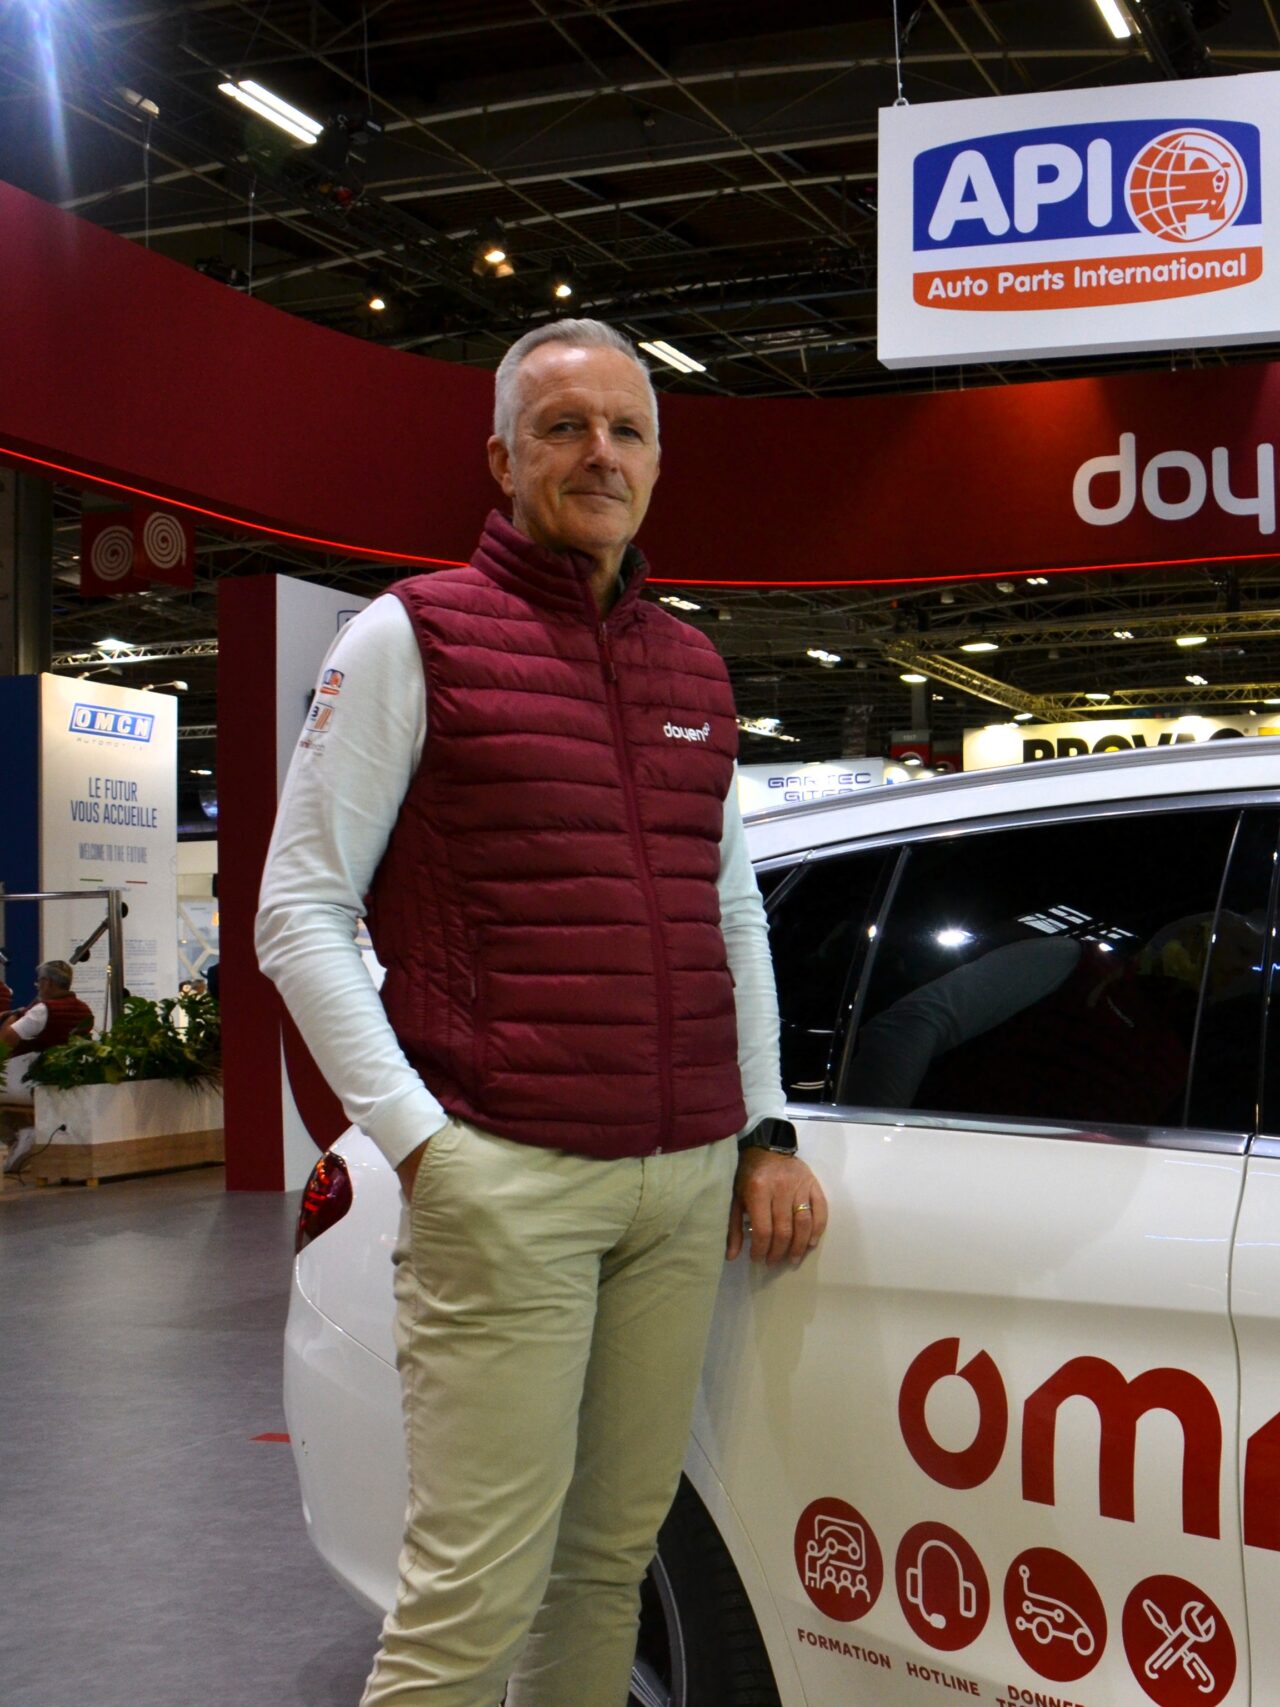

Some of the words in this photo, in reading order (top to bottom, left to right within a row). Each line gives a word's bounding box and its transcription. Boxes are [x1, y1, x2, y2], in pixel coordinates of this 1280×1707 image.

[928, 138, 1113, 241] API
[927, 275, 988, 300] Auto
[997, 267, 1065, 294] Parts
[1073, 253, 1248, 289] International
[75, 709, 149, 737] OMCN
[663, 722, 706, 742] doyen
[88, 777, 101, 798] LE
[105, 779, 138, 802] FUTUR
[70, 800, 100, 823] VOUS
[103, 804, 158, 828] ACCUEILLE
[797, 1628, 891, 1669] FORMATION
[907, 1662, 980, 1696] HOTLINE
[1008, 1685, 1085, 1707] DONN
